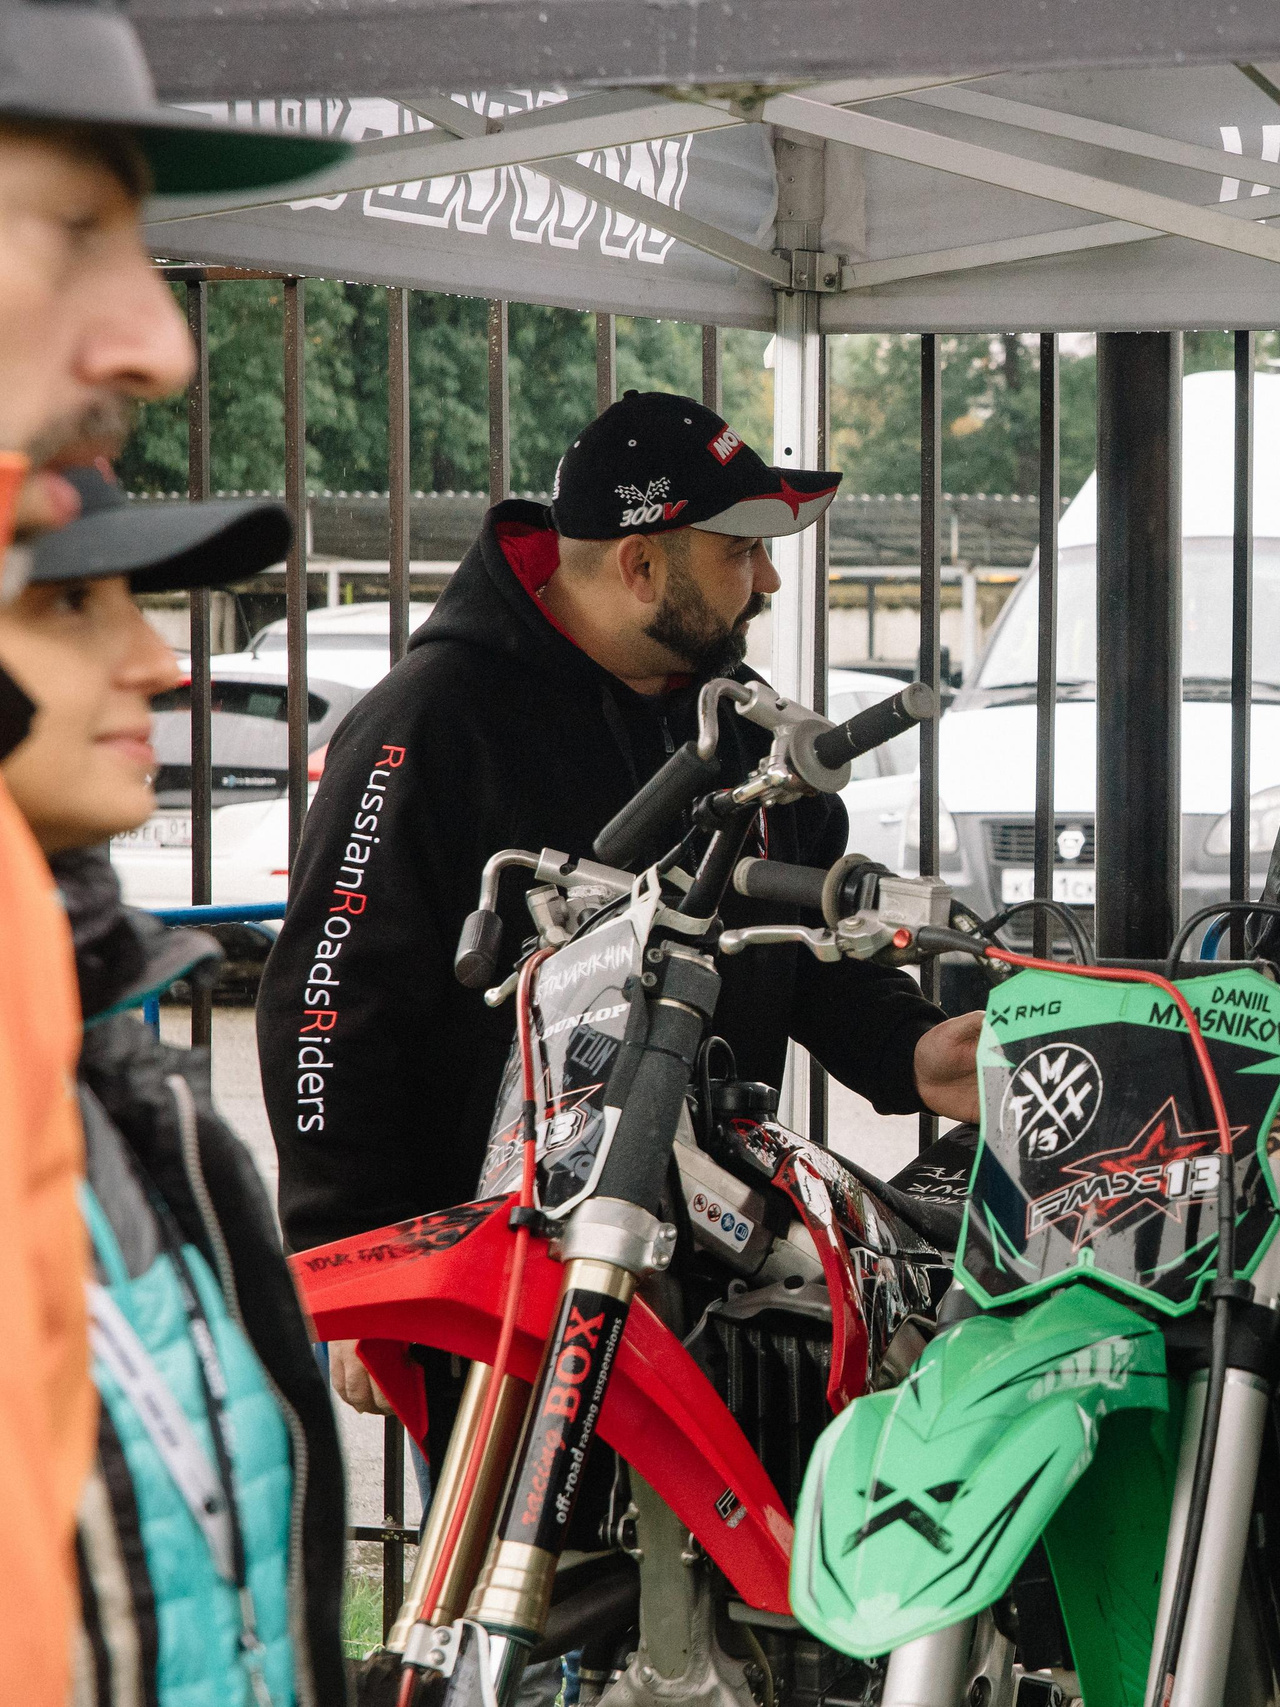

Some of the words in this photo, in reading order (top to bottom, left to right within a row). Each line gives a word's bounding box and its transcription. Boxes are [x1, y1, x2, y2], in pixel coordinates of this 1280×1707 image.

[620, 500, 688, 527] 300V
[1211, 986, 1271, 1013] DANIIL
[541, 1003, 631, 1041] DUNLOP
[543, 1305, 605, 1424] BOX
[556, 1446, 585, 1525] off-road
[578, 1403, 599, 1450] racing
[591, 1317, 623, 1404] suspensions
